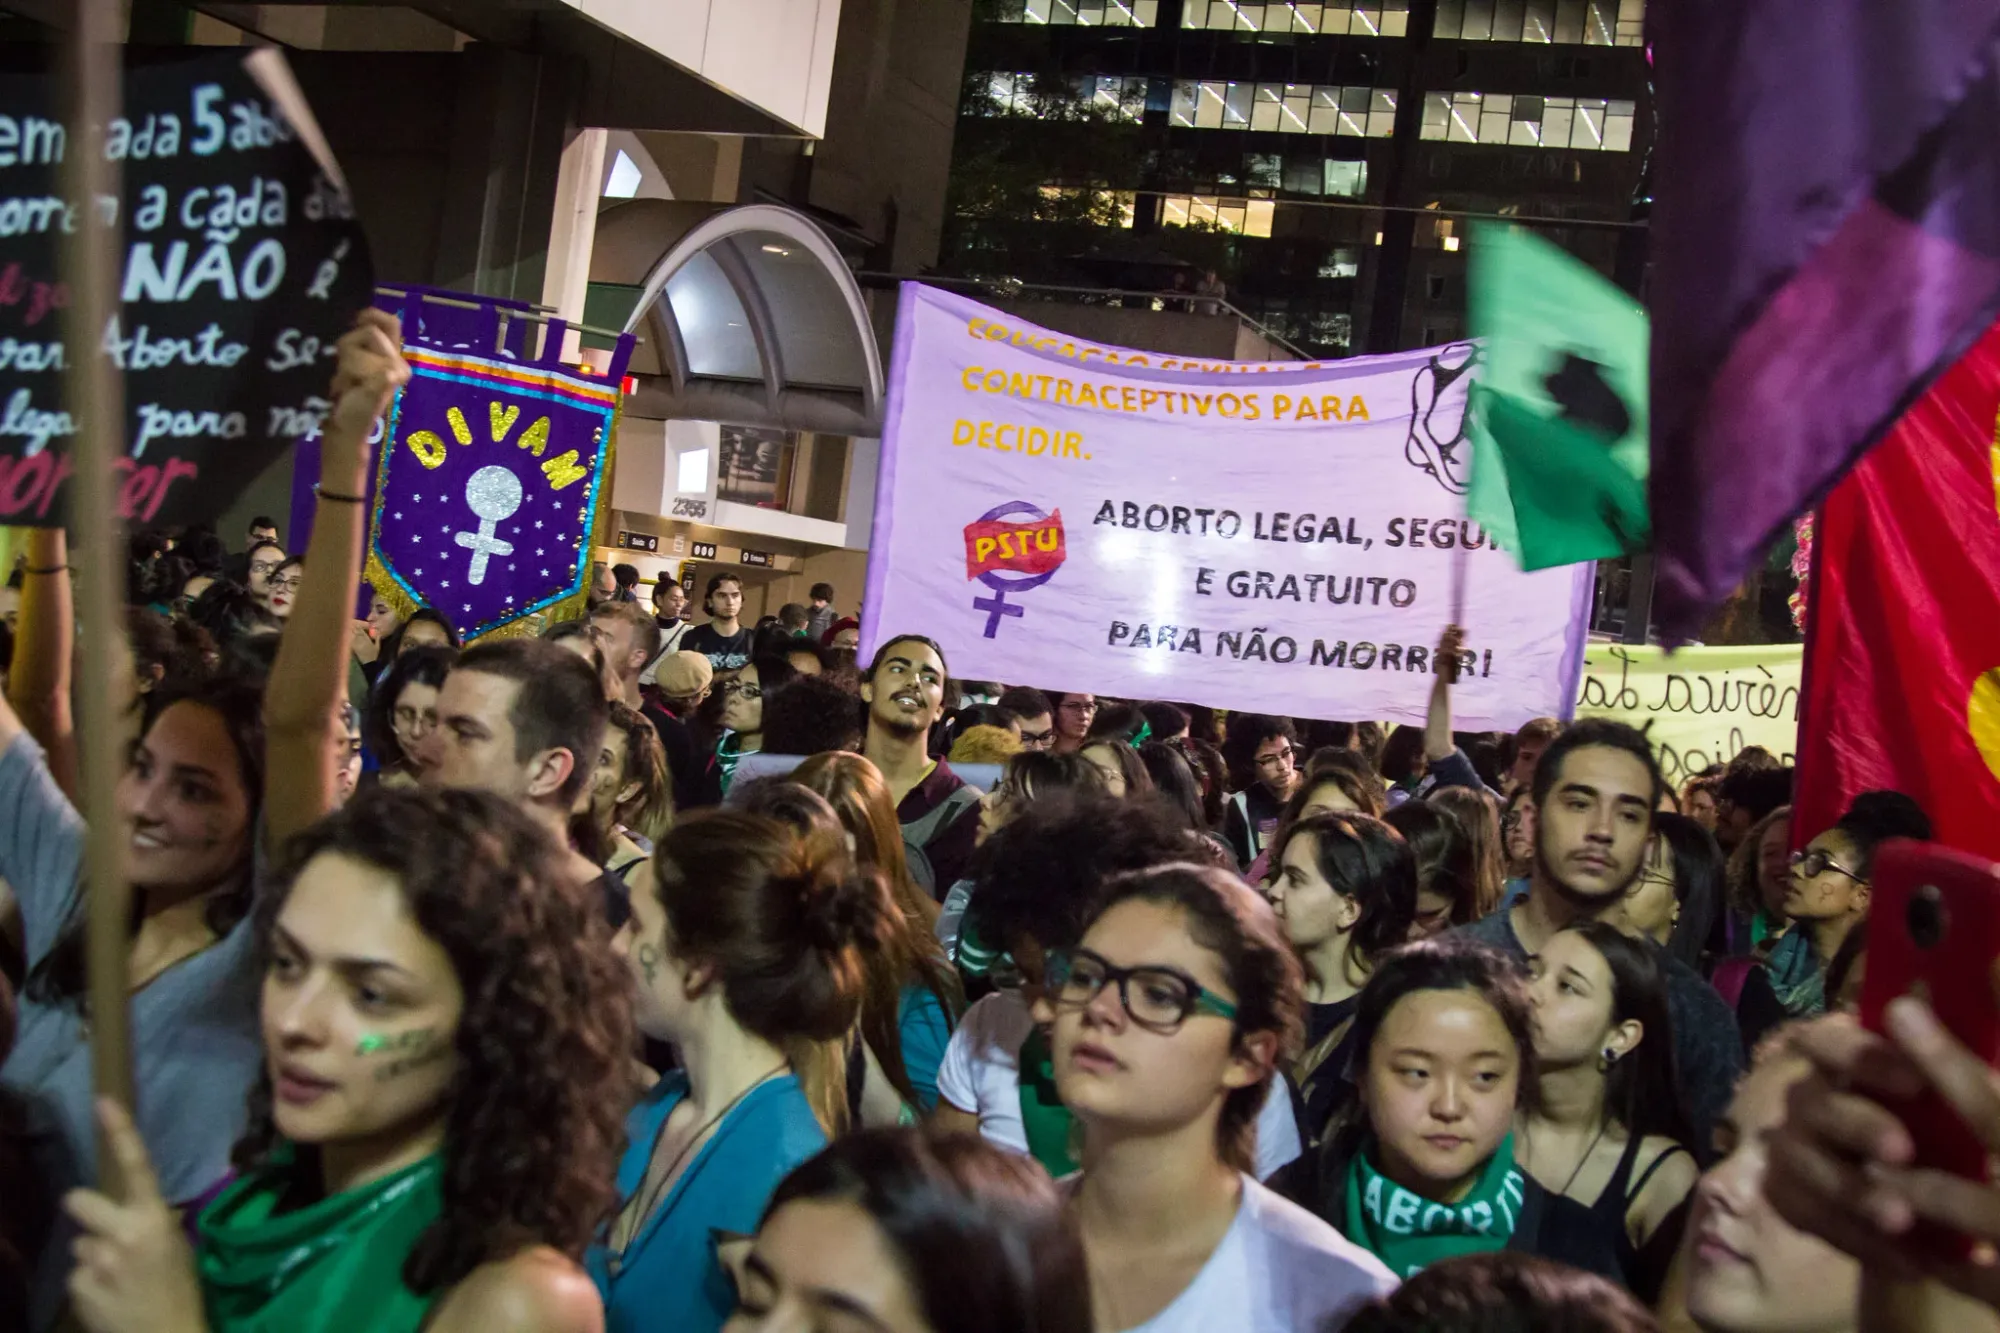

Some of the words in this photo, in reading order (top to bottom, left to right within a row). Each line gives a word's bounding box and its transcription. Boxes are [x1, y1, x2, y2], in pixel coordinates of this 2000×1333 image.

[92, 113, 182, 161] ada
[191, 82, 226, 156] 5
[135, 184, 167, 231] a
[180, 177, 287, 229] cada
[121, 227, 286, 302] NÃO
[961, 366, 1261, 420] CONTRACEPTIVOS
[1273, 393, 1369, 421] PARA
[130, 402, 248, 460] para
[406, 401, 588, 491] DIVAM
[952, 418, 1092, 461] DECIDIR.
[975, 527, 1058, 563] PSTU
[1093, 499, 1242, 539] ABORTO
[1254, 511, 1373, 551] LEGAL,
[1385, 517, 1498, 551] SEGU
[1195, 566, 1215, 596] E
[1226, 570, 1417, 608] GRATUITO
[1108, 620, 1202, 654] PARA
[1216, 627, 1298, 664] NÃO
[1310, 639, 1493, 679] MORRR!
